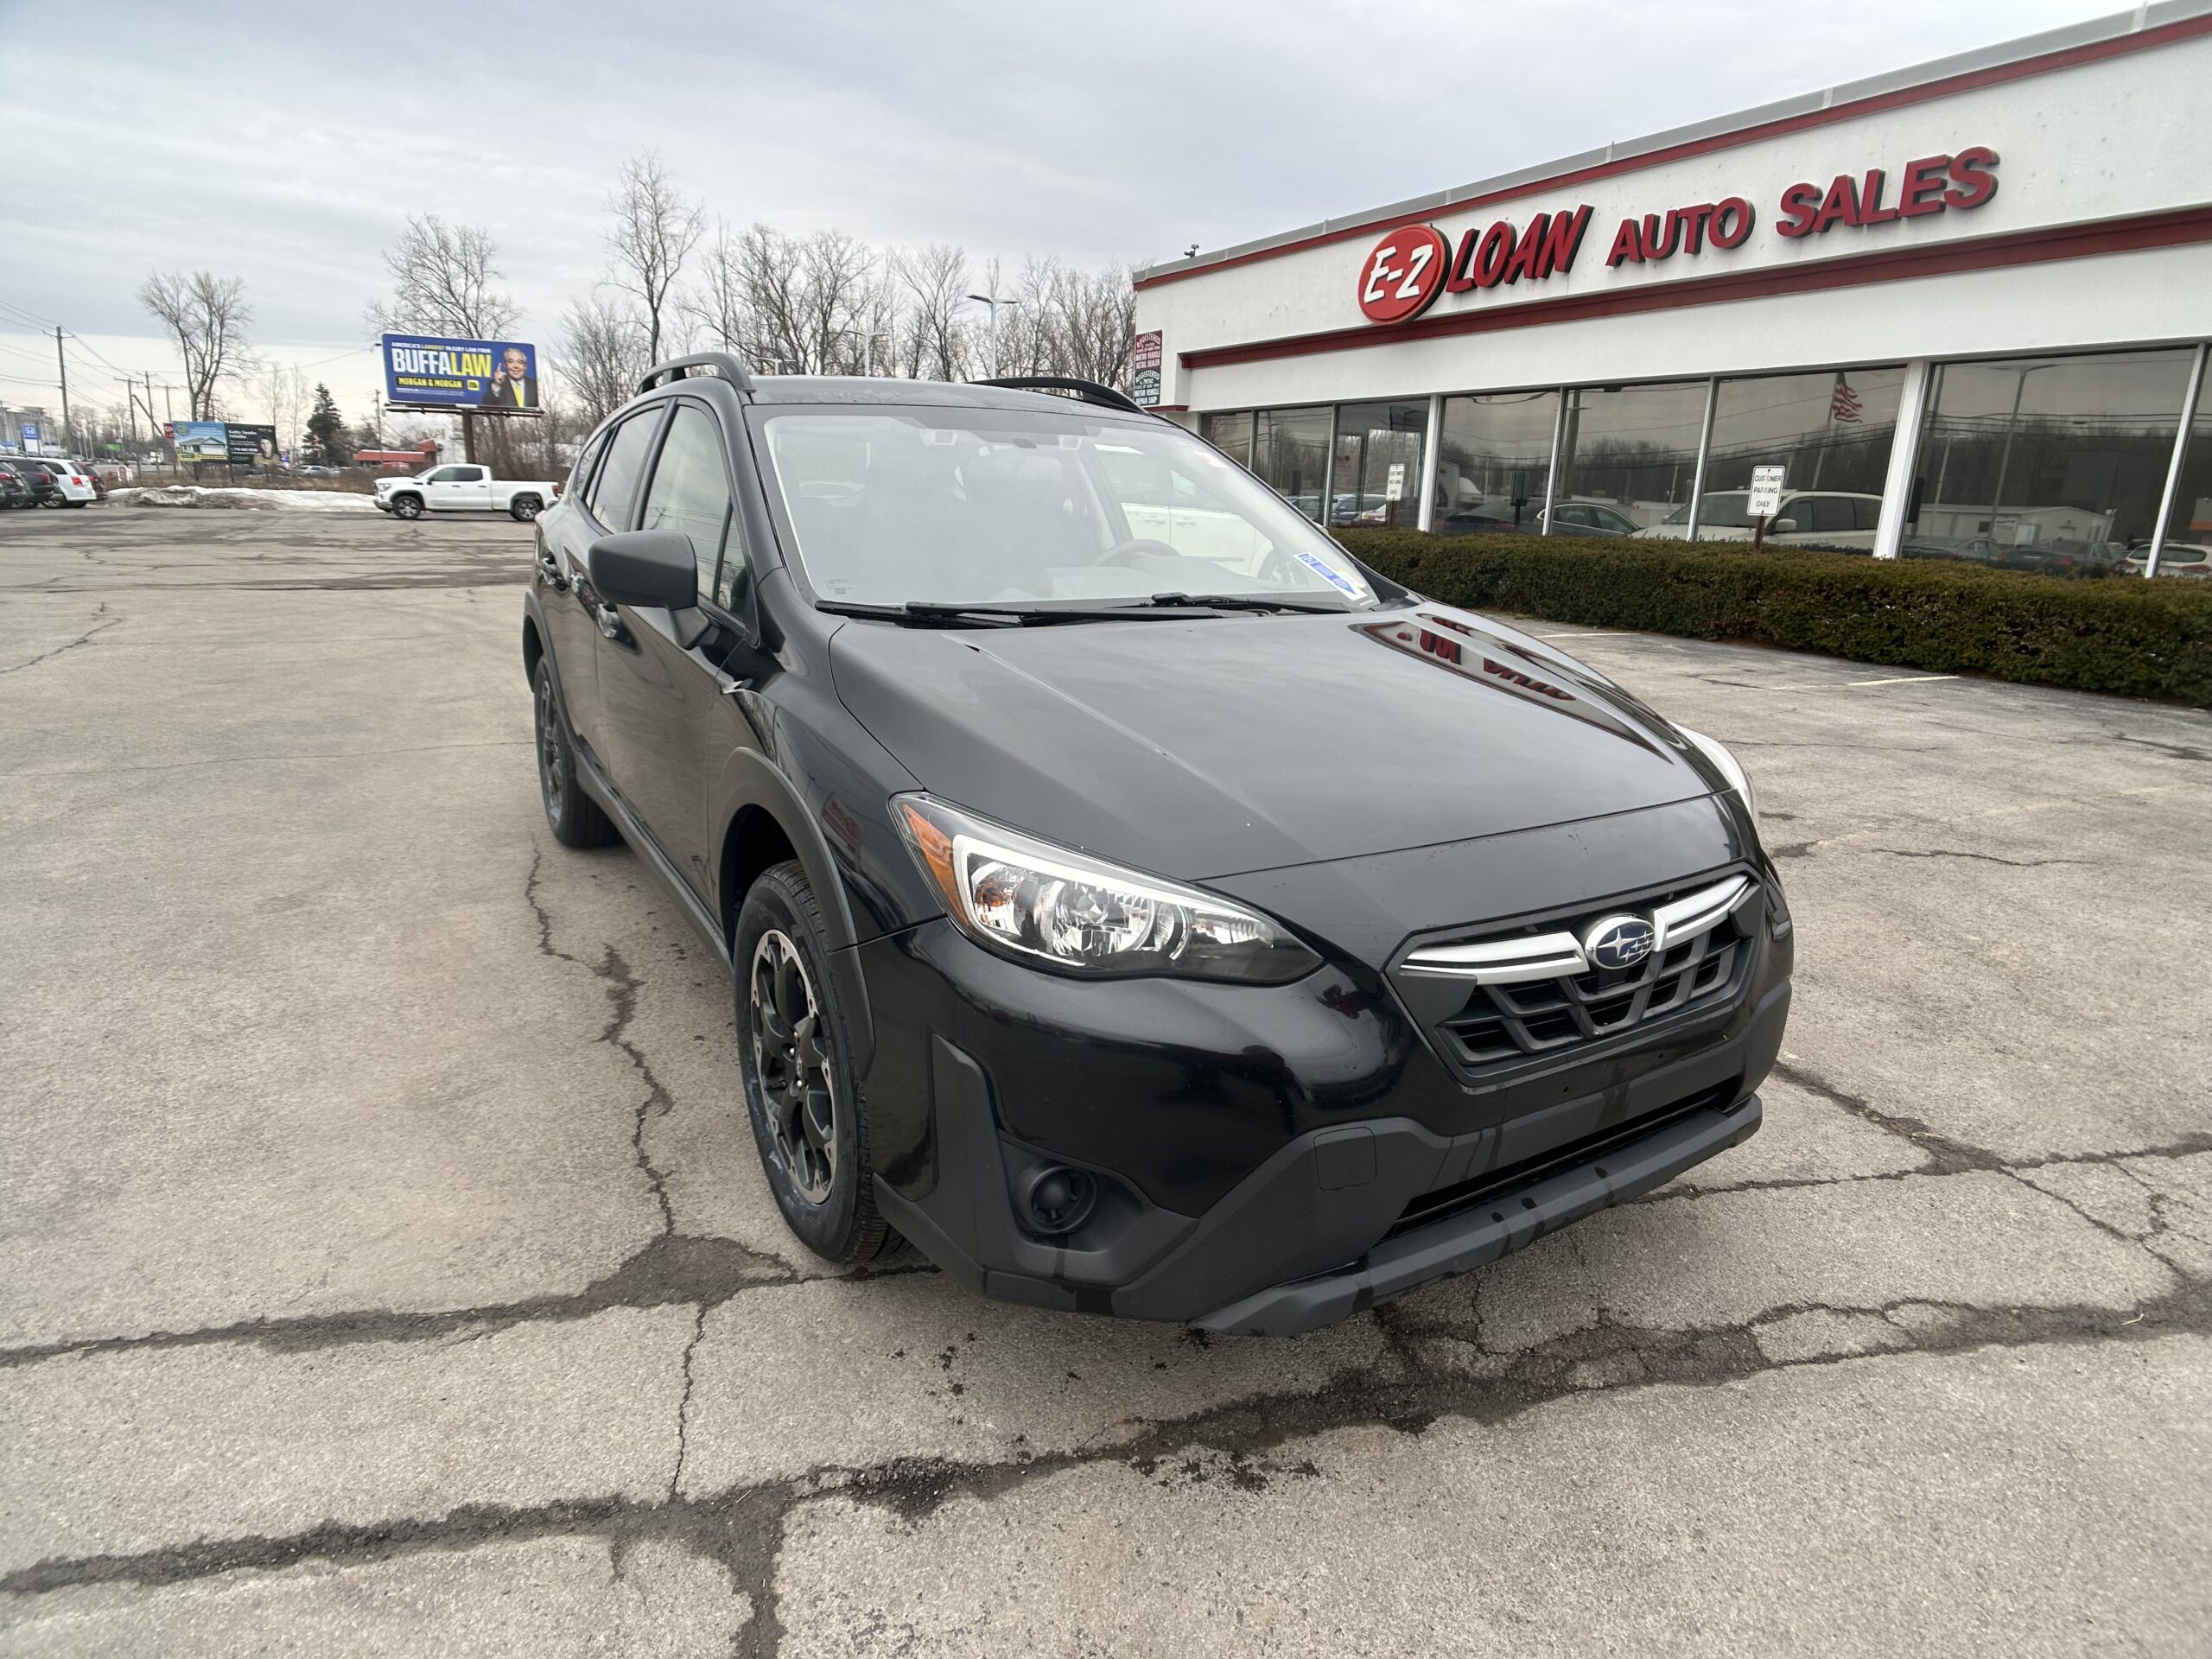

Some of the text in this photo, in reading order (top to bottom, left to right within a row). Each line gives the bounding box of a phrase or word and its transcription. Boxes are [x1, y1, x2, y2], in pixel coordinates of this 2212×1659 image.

[1363, 146, 2000, 303] E-Z LOAN AUTO SALES
[1136, 333, 1160, 348] REGISTERED
[1147, 350, 1160, 359] VEHICLE
[391, 347, 492, 378] BUFFALAW
[398, 377, 463, 388] MORGAN & MORGAN
[1135, 370, 1160, 384] REGISTERED
